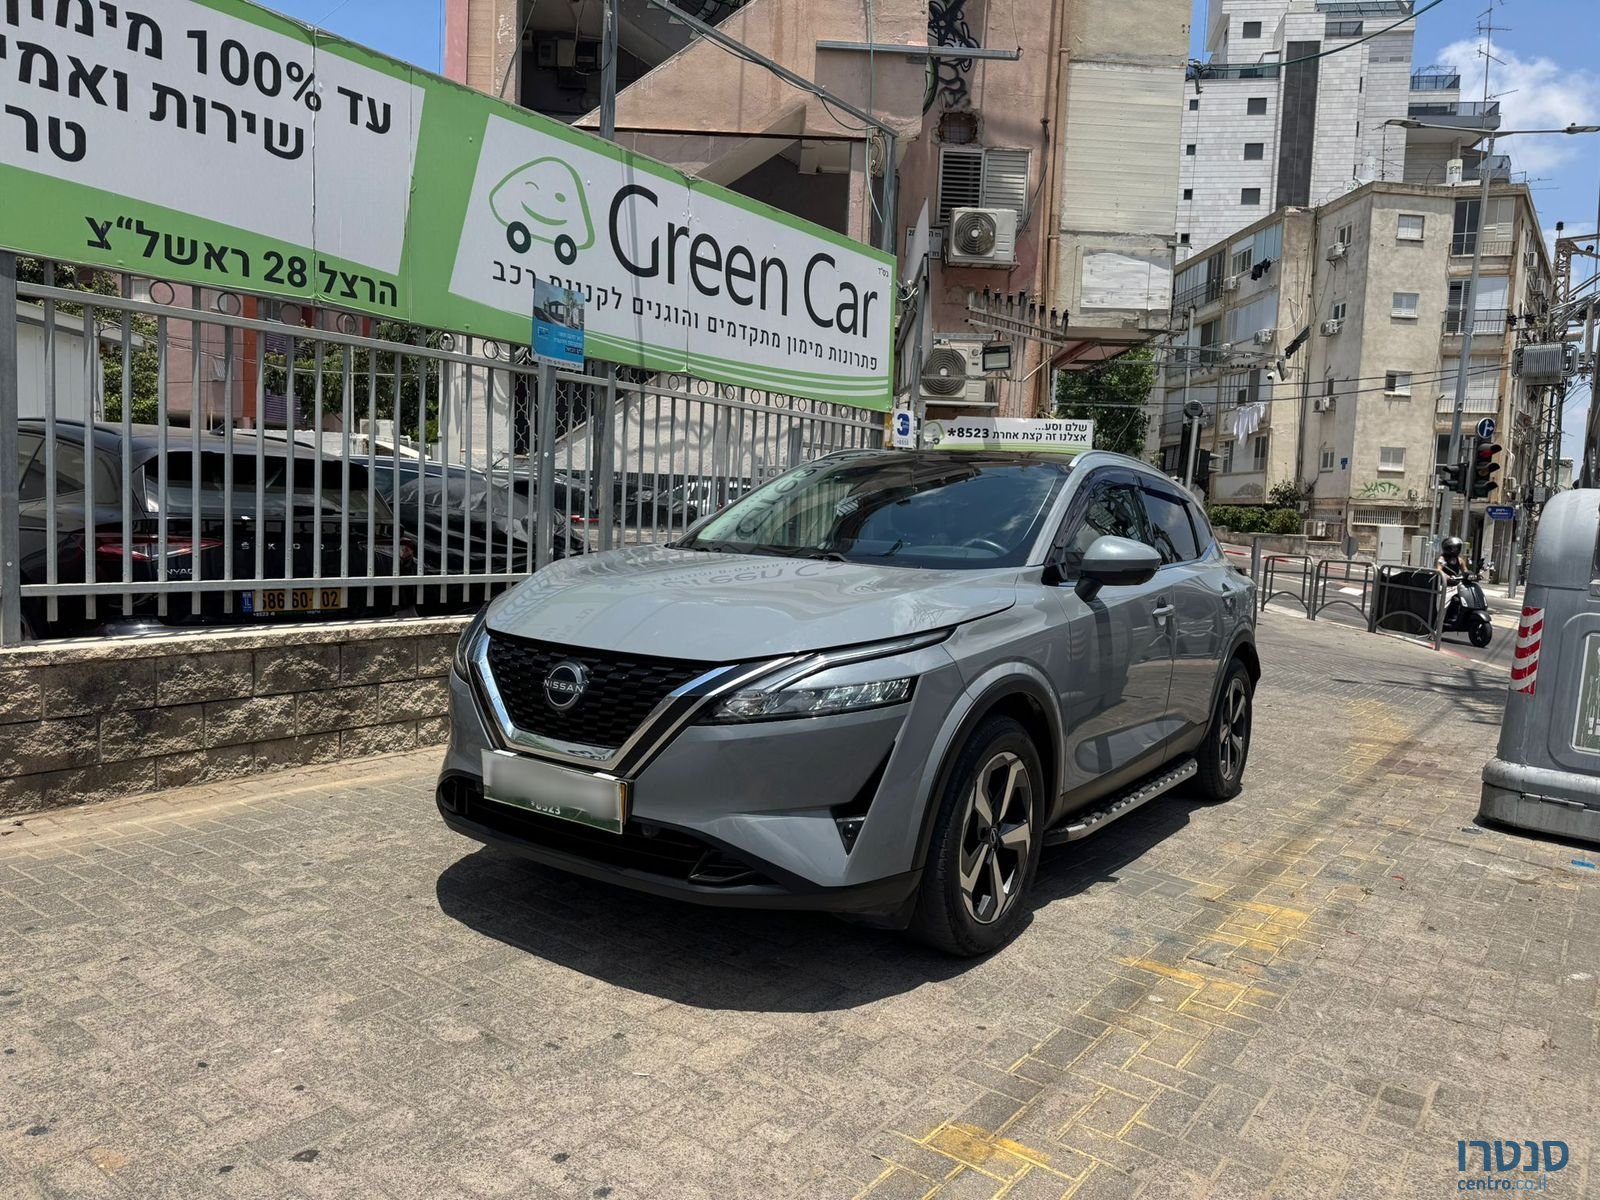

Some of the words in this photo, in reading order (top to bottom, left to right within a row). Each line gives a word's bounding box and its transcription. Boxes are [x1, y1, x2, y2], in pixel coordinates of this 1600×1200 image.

[187, 30, 321, 112] 100%
[150, 82, 303, 160] שירות
[338, 86, 391, 134] עד
[263, 251, 307, 289] 28
[609, 184, 787, 316] Green
[804, 253, 877, 338] Car
[319, 261, 397, 307] הרצל
[493, 261, 536, 289] רכב
[633, 297, 698, 329] והוגנים
[708, 316, 780, 347] מתקדמים
[787, 336, 823, 358] מימון
[828, 346, 877, 371] פתרונות
[897, 413, 910, 436] 3
[992, 431, 1020, 440] אחרת
[1022, 432, 1042, 443] קצת
[1045, 433, 1057, 441] זה
[1060, 432, 1087, 442] אצלנו
[1065, 422, 1088, 432] שלם
[543, 679, 584, 694] NISSAN
